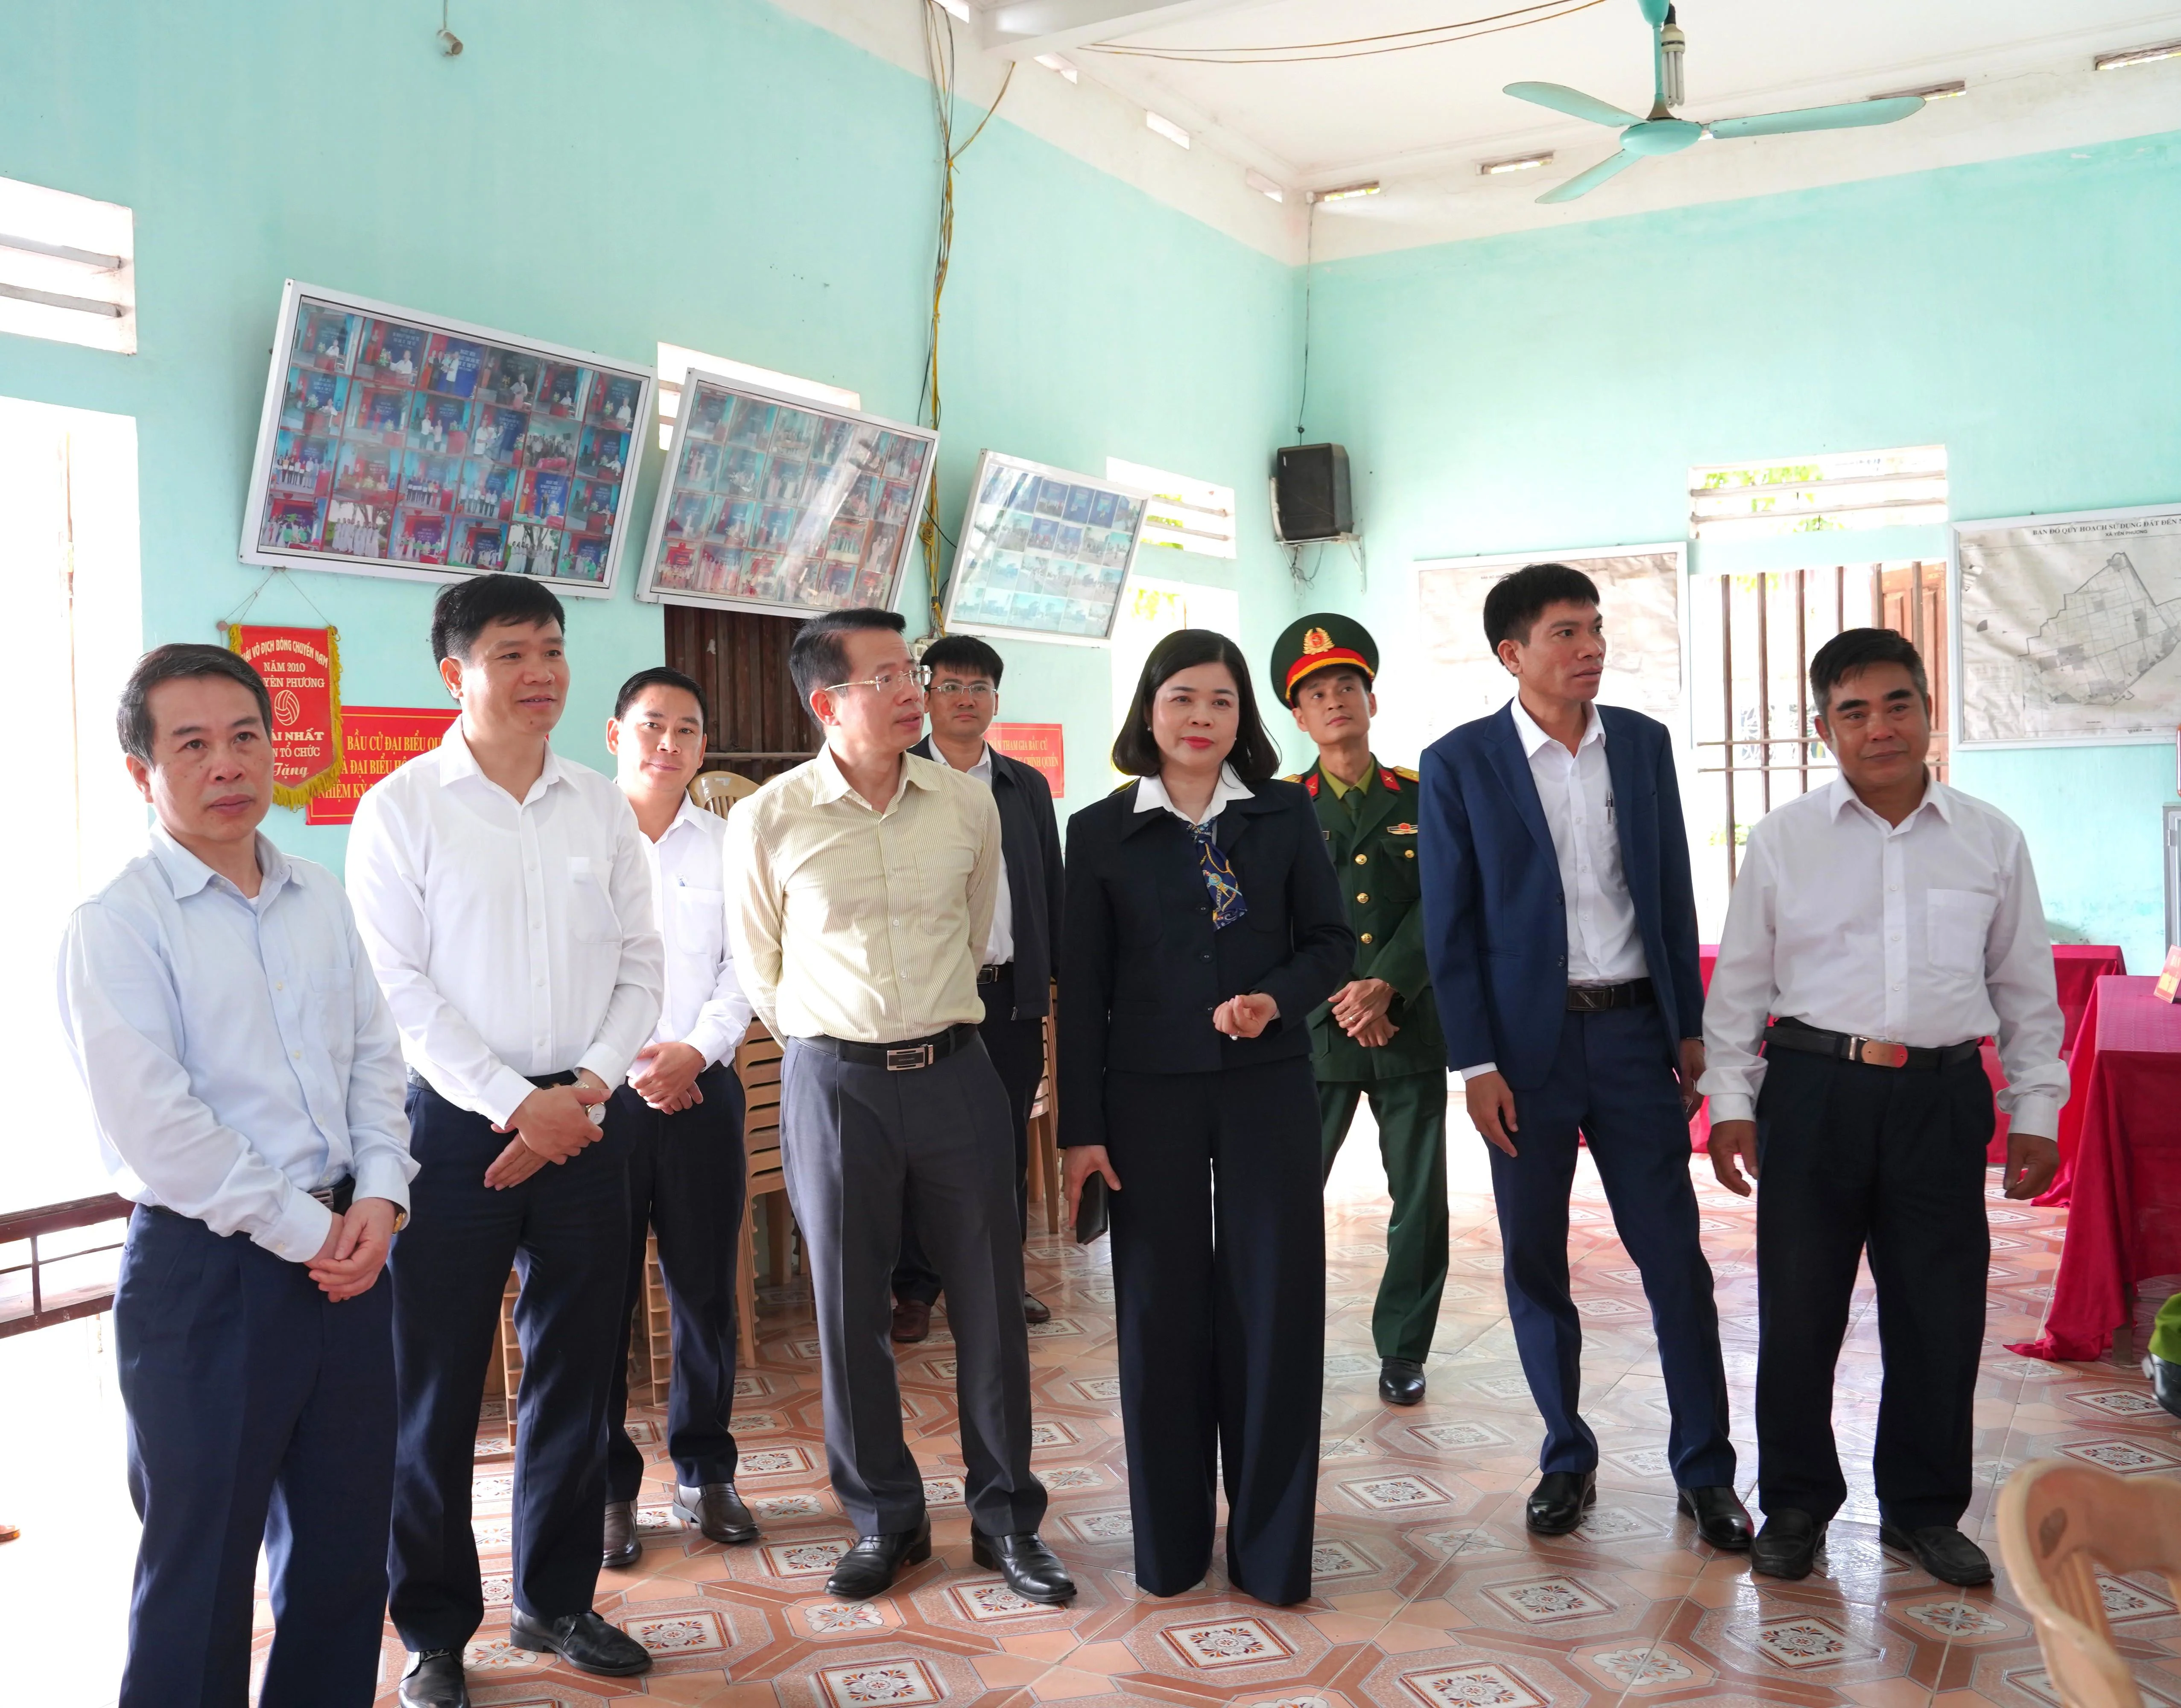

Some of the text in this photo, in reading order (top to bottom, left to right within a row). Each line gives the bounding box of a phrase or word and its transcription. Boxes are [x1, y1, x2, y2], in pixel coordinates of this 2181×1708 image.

[261, 640, 274, 655] ĐỊCH
[275, 637, 292, 651] BÓNG
[315, 650, 328, 668] NAM
[263, 660, 305, 672] NĂM 2010
[262, 675, 325, 687] YÊN PHƯƠNG
[284, 728, 325, 741] NHẤT
[369, 731, 383, 751] CỬ
[384, 736, 402, 755] ĐẠI
[403, 729, 426, 751] BIỂU
[1003, 740, 1018, 751] THAM
[1018, 740, 1028, 751] GIA
[1040, 737, 1048, 751] CỬ
[280, 742, 292, 757] TỔ
[294, 744, 320, 757] CHỨC
[350, 760, 368, 778] ĐẠI
[370, 752, 392, 774] BIỂU
[1023, 753, 1041, 767] CHÍNH
[273, 763, 310, 779] Tặng
